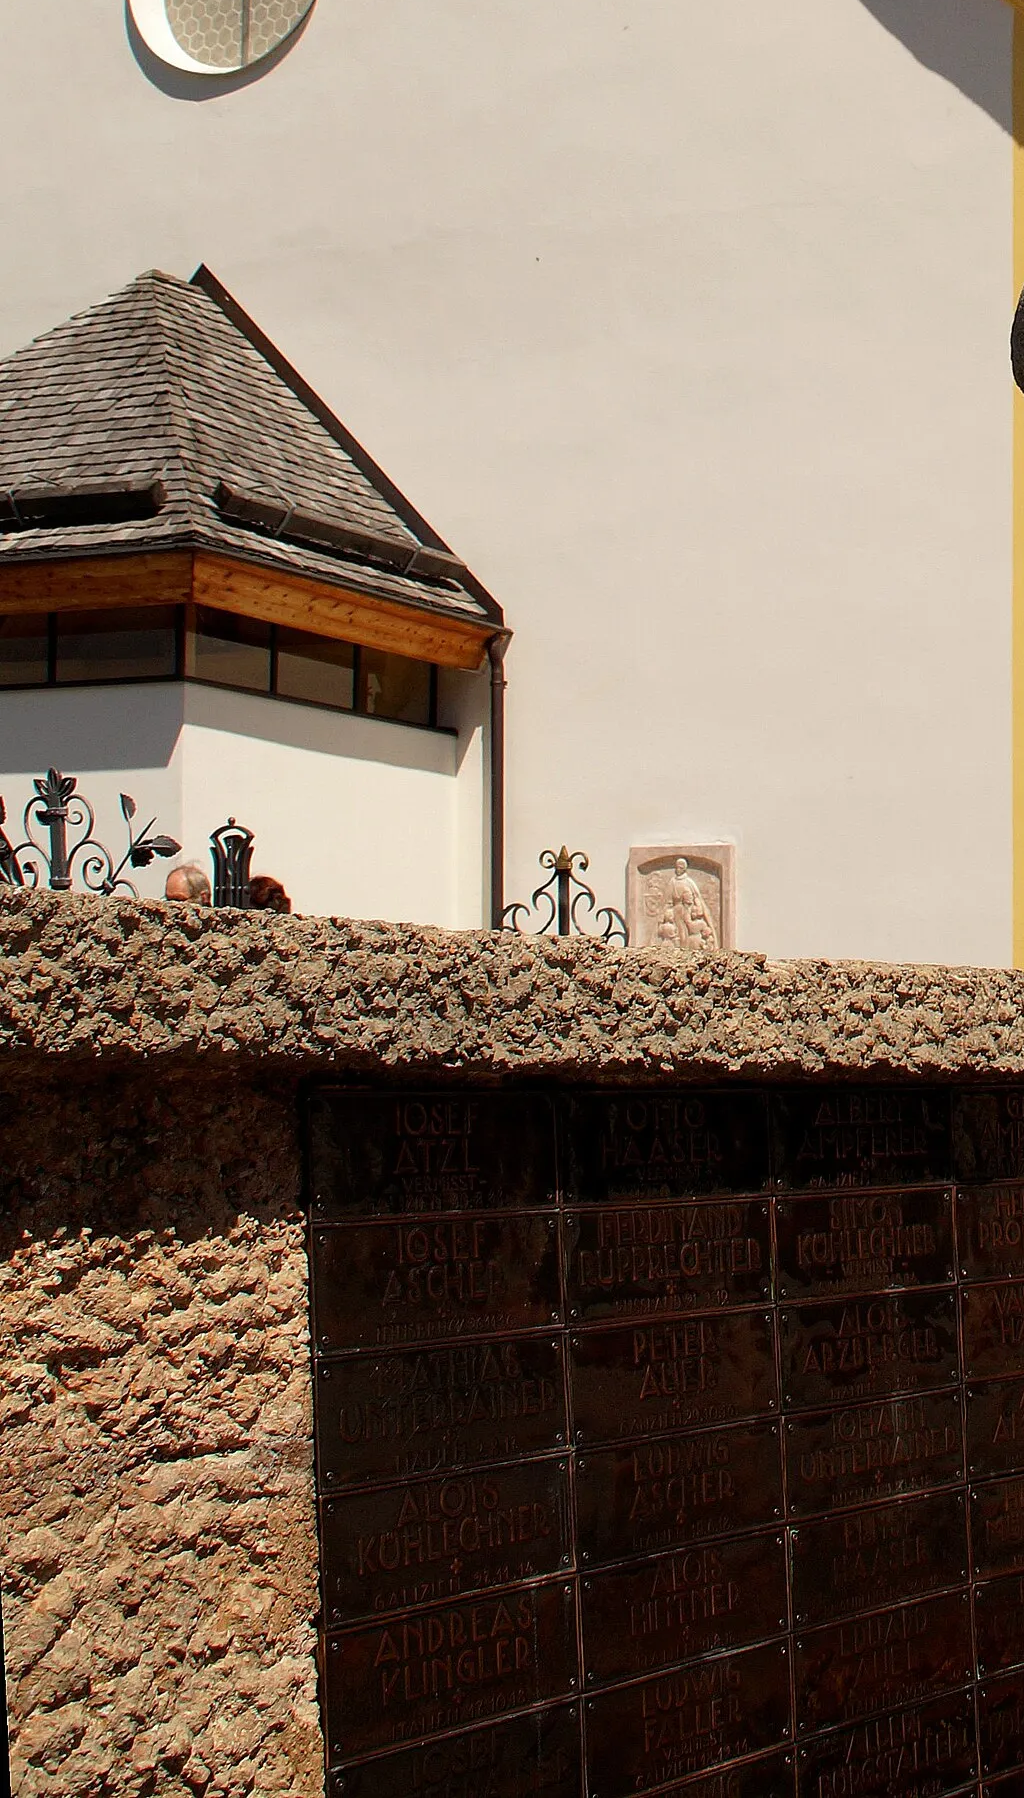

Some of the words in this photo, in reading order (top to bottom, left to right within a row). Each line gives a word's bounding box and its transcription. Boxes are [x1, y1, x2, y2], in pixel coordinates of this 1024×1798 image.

[626, 1098, 706, 1131] OTTO
[393, 1138, 481, 1176] ATZL
[600, 1129, 724, 1170] HAASER
[796, 1126, 928, 1161] AMPFERER
[598, 1205, 744, 1248] FERDINAND
[829, 1194, 904, 1230] SIMON
[382, 1259, 506, 1308] ASCHER
[580, 1236, 763, 1287] RUPPRECHTER
[633, 1320, 718, 1365] PETER
[838, 1298, 912, 1339] ALOIS
[639, 1356, 717, 1401] AUER
[339, 1378, 558, 1443] UNTERRAINER
[633, 1434, 730, 1483] LUDWIG
[800, 1426, 957, 1484] UNTERRAINER
[397, 1478, 500, 1529] ALOIS
[628, 1468, 736, 1523] ASCHER
[357, 1501, 551, 1577] KÜHLECHNER
[651, 1549, 724, 1598] ALOIS
[373, 1595, 533, 1668] ANDREAS
[381, 1636, 532, 1706] KLINGLER
[641, 1662, 742, 1719] LUDWIG
[643, 1694, 743, 1753] FALLER
